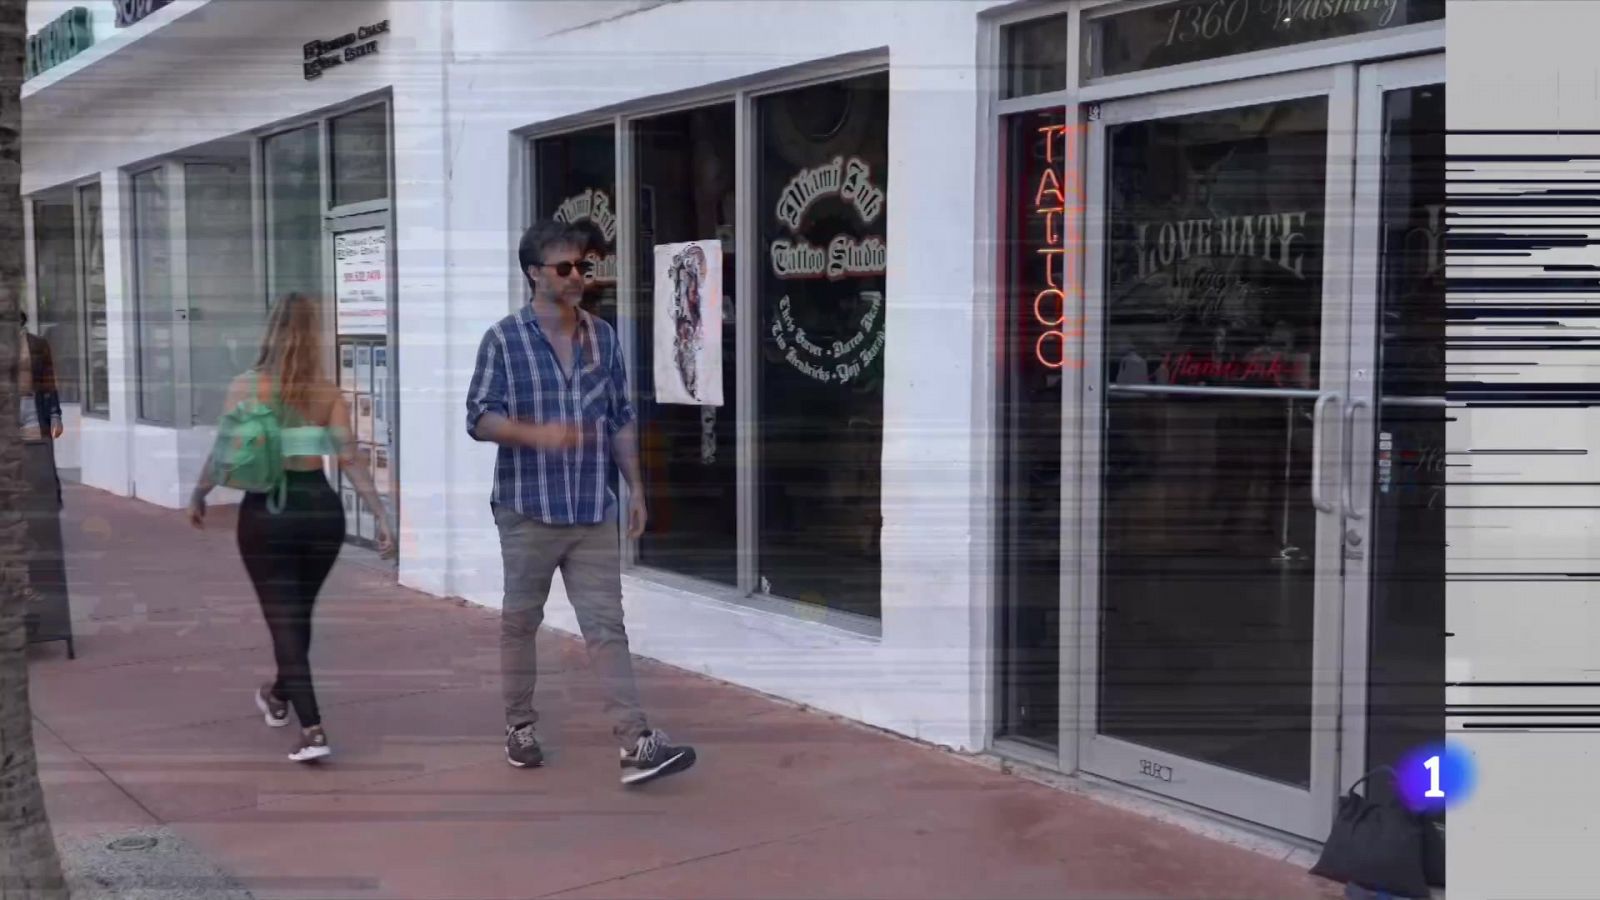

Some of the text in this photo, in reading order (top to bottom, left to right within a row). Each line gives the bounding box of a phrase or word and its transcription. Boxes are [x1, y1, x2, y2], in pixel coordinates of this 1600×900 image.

[777, 156, 884, 231] Miami Ink
[771, 236, 886, 277] Tattoo Studio
[1134, 219, 1212, 280] LOVE
